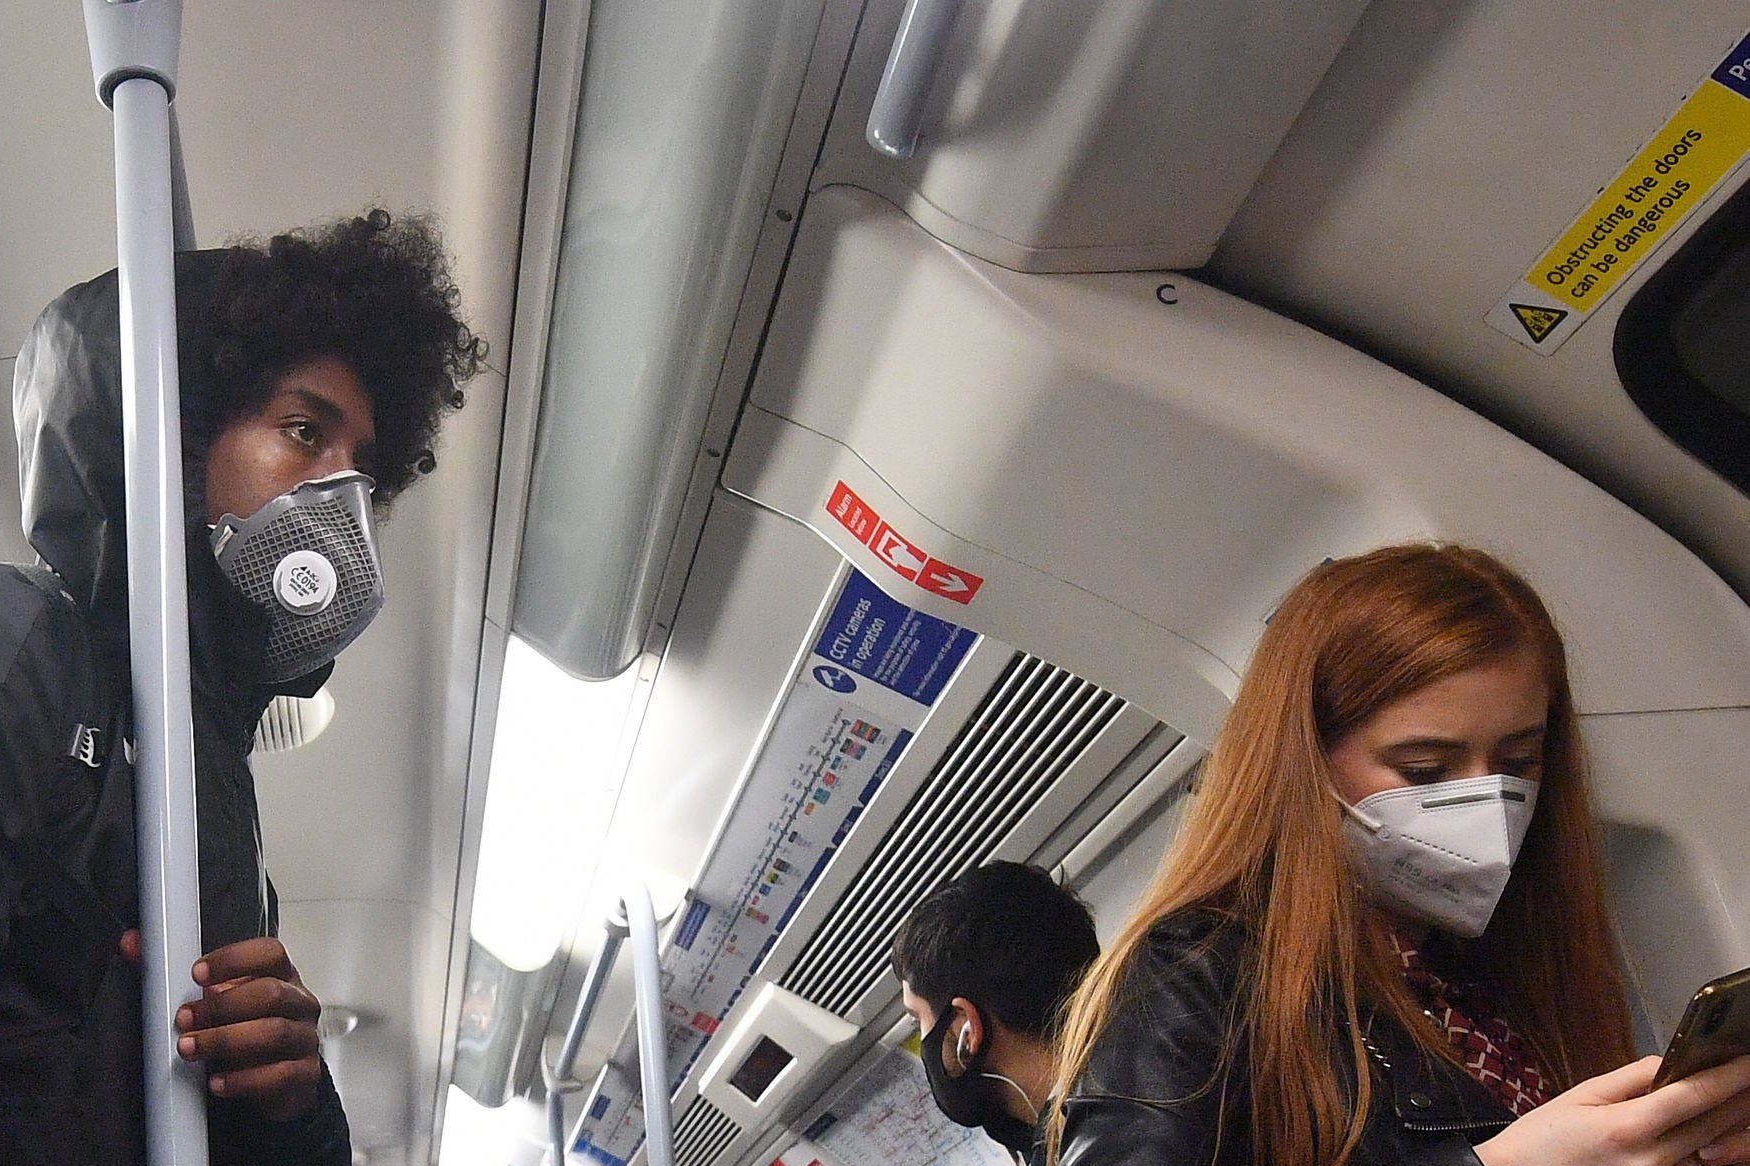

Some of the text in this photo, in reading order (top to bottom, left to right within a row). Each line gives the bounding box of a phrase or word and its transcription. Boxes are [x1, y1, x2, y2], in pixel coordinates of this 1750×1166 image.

[1546, 127, 1702, 286] Obstructing the doors
[1570, 177, 1691, 300] can be dangerous
[1156, 284, 1178, 305] C
[834, 492, 854, 520] Alarm
[829, 598, 872, 661] CCTV cameras
[849, 617, 886, 671] in operation
